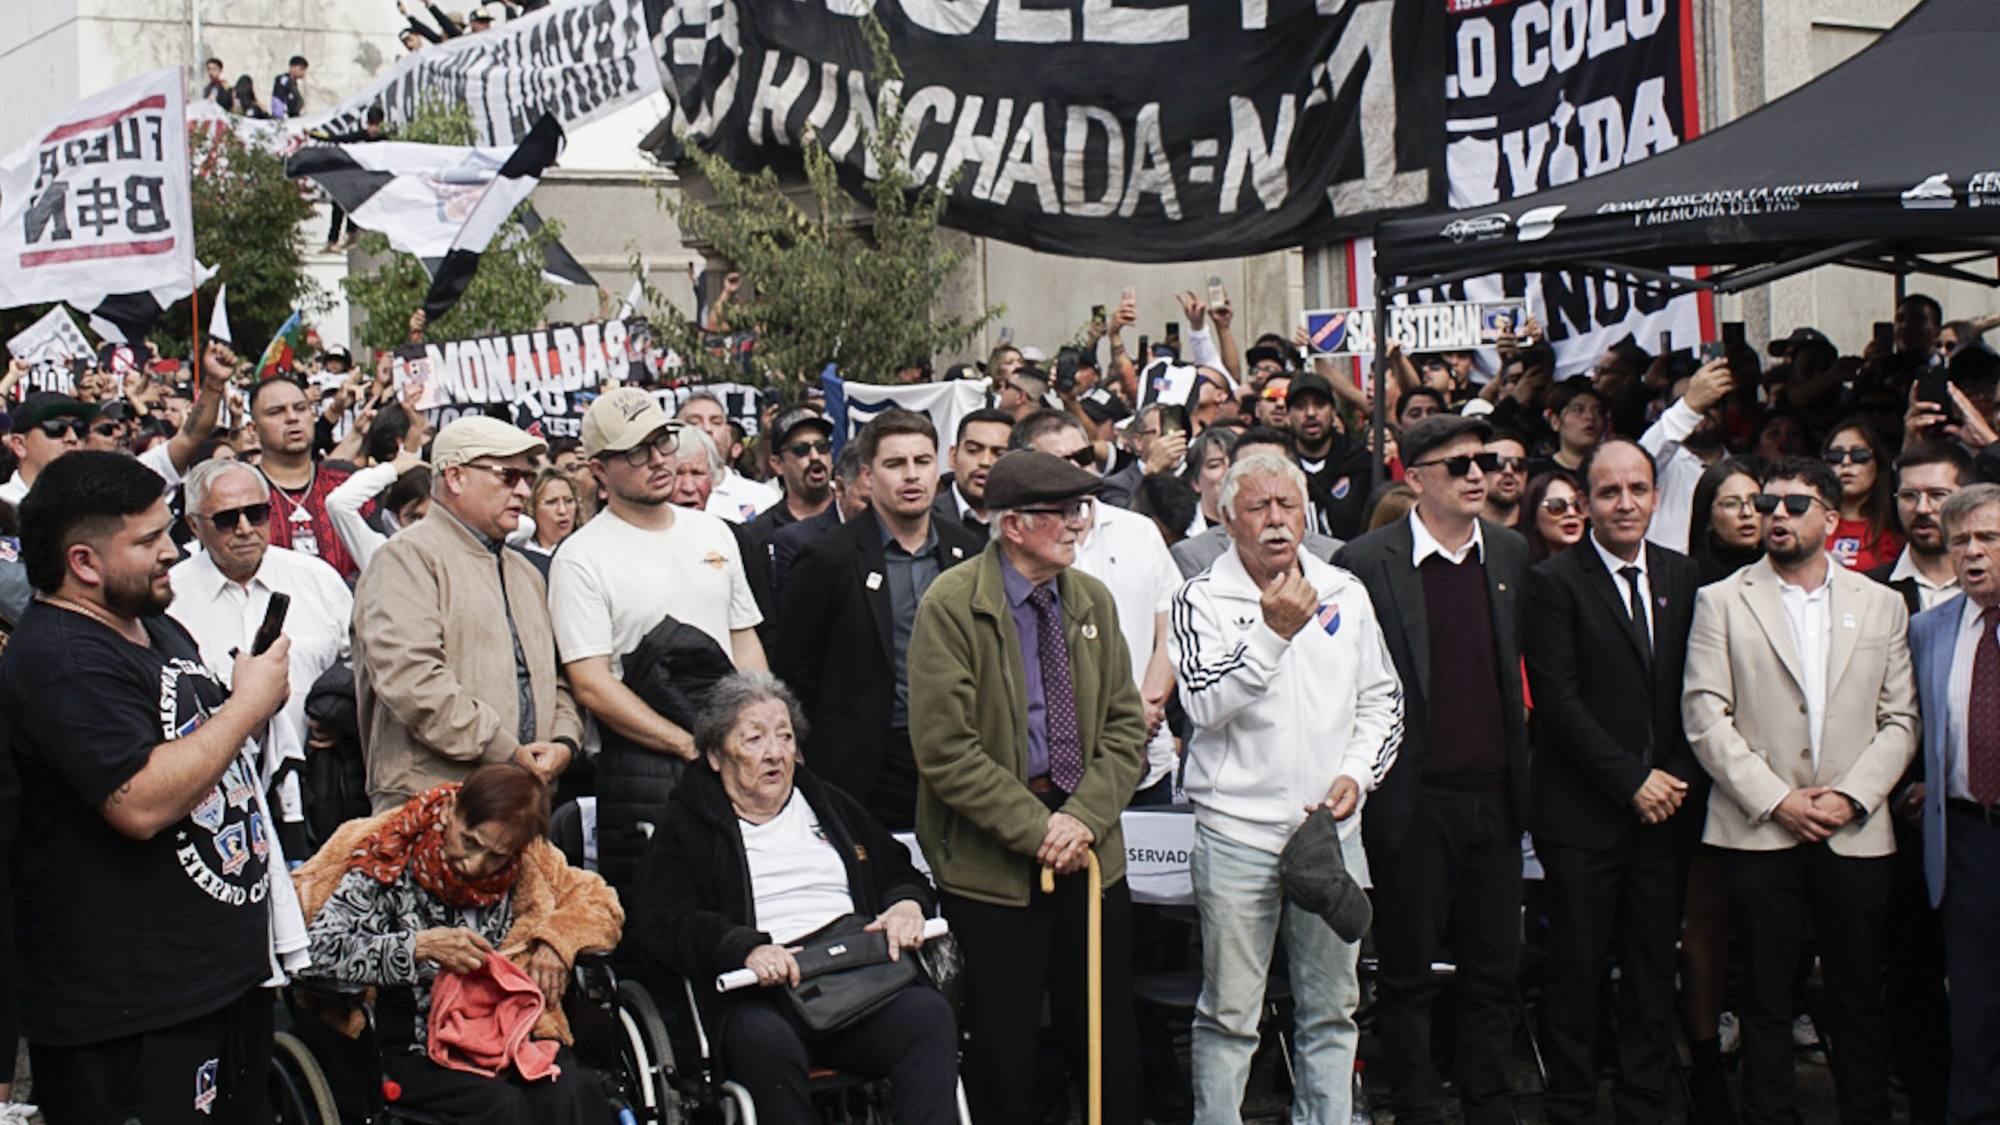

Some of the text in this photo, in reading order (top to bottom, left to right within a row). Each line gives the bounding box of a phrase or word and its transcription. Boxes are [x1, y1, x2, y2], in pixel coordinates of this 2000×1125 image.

[1729, 197, 1761, 216] DEL
[1346, 310, 1384, 352] SA
[1391, 303, 1481, 351] ESTEBAN
[425, 320, 630, 404] MONALBAS
[176, 842, 247, 906] ETERNO
